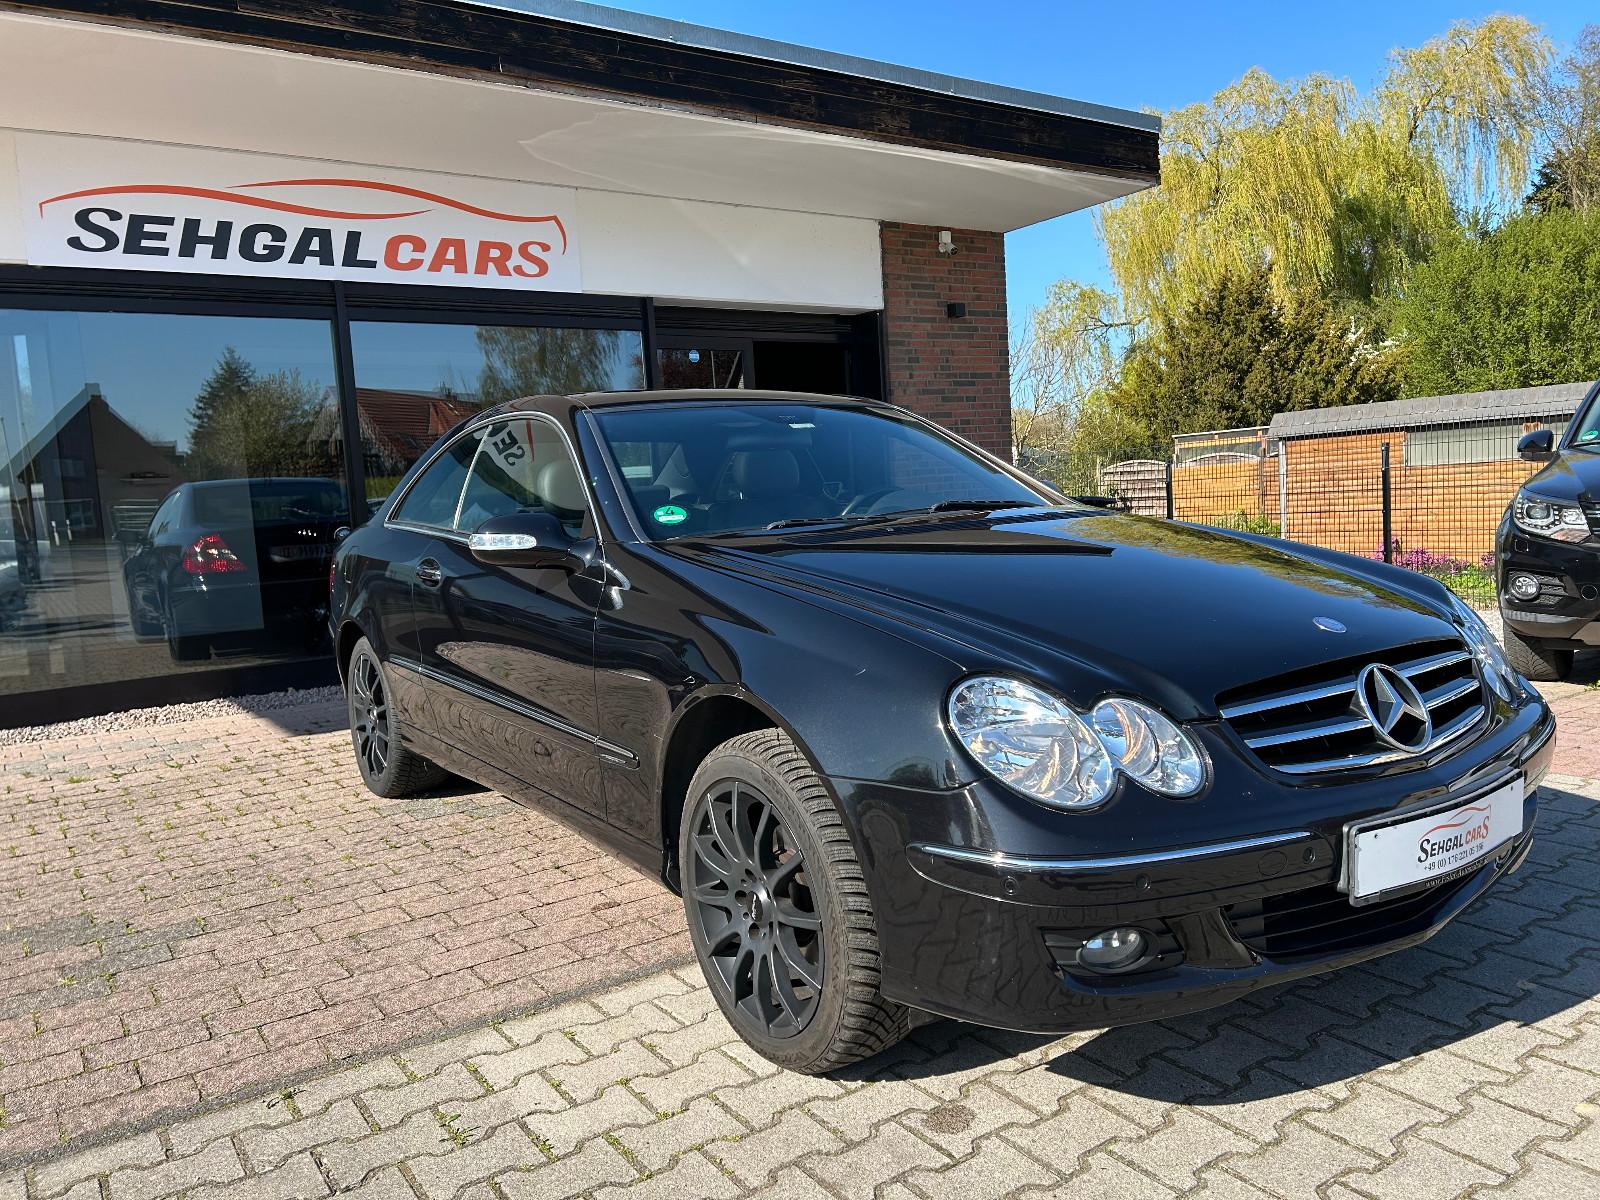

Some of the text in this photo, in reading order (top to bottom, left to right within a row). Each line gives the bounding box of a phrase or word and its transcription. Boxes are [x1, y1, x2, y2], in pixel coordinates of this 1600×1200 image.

[665, 506, 675, 516] 4
[1424, 861, 1436, 871] +49
[1437, 858, 1447, 869] (0)
